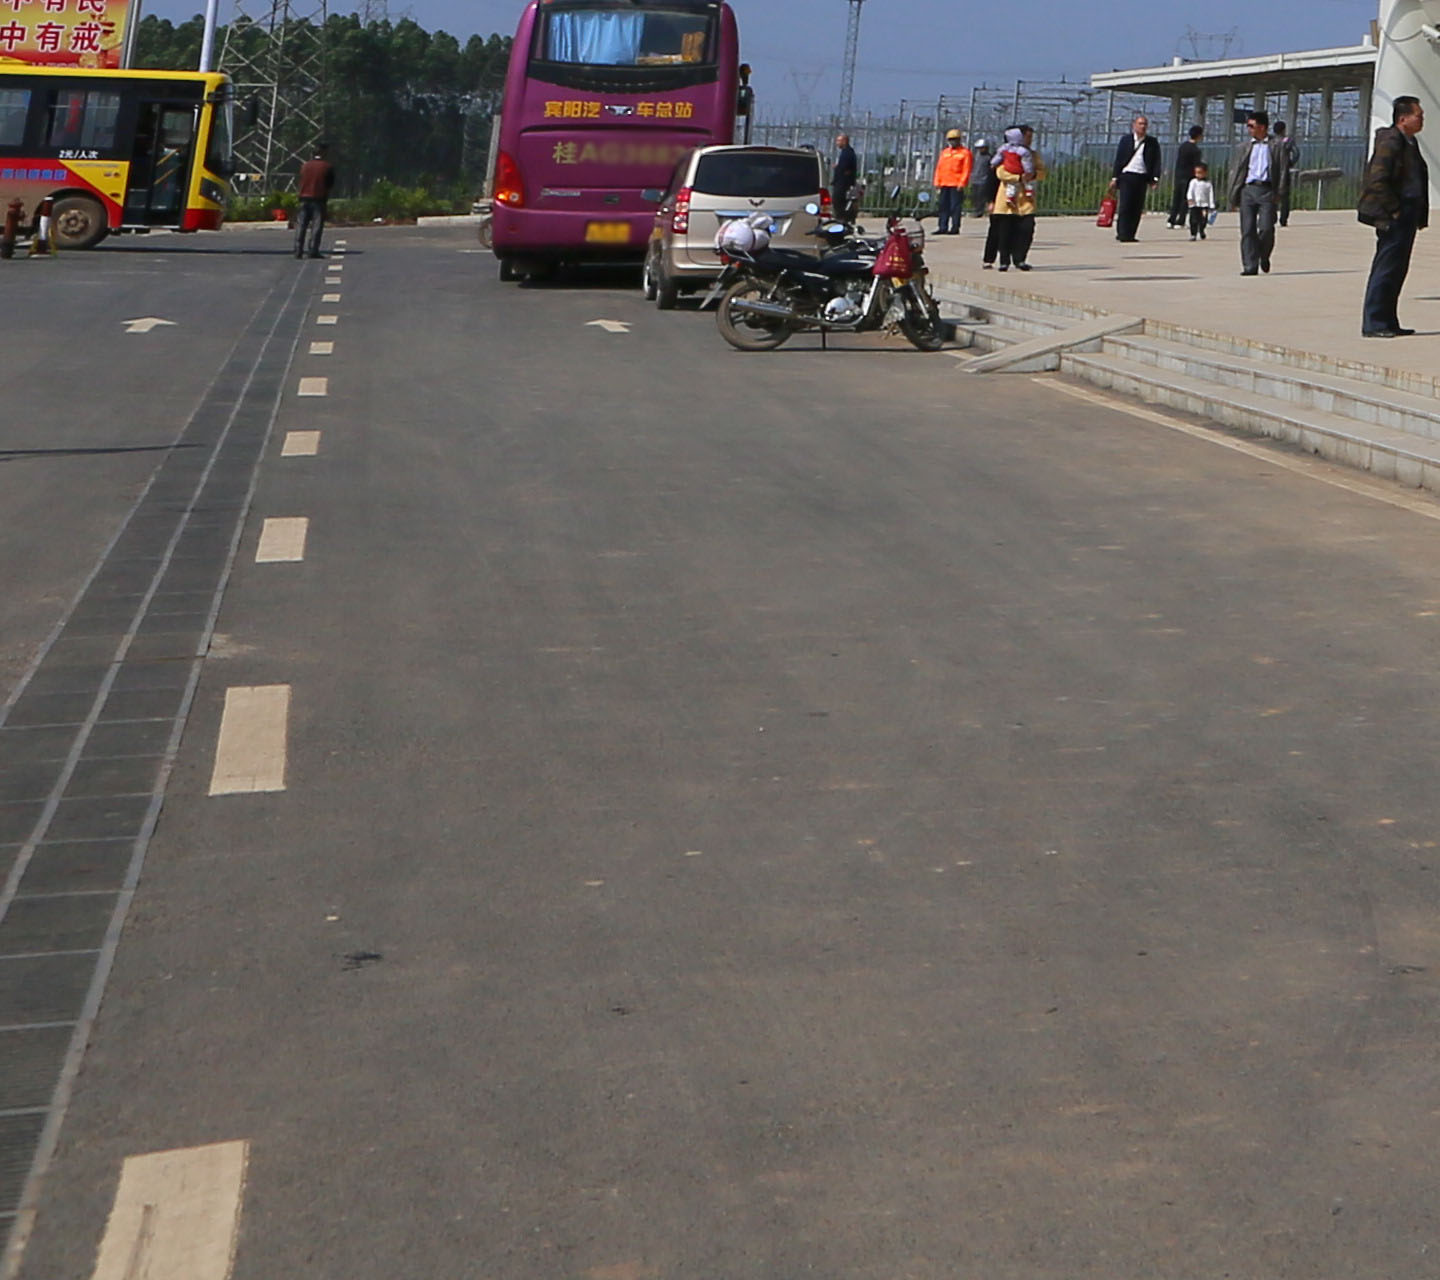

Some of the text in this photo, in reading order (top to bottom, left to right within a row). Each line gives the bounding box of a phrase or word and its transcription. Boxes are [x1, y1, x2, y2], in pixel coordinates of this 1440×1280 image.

[0, 20, 102, 53] 中有戒
[544, 100, 693, 119] 宾阳汽 车总站
